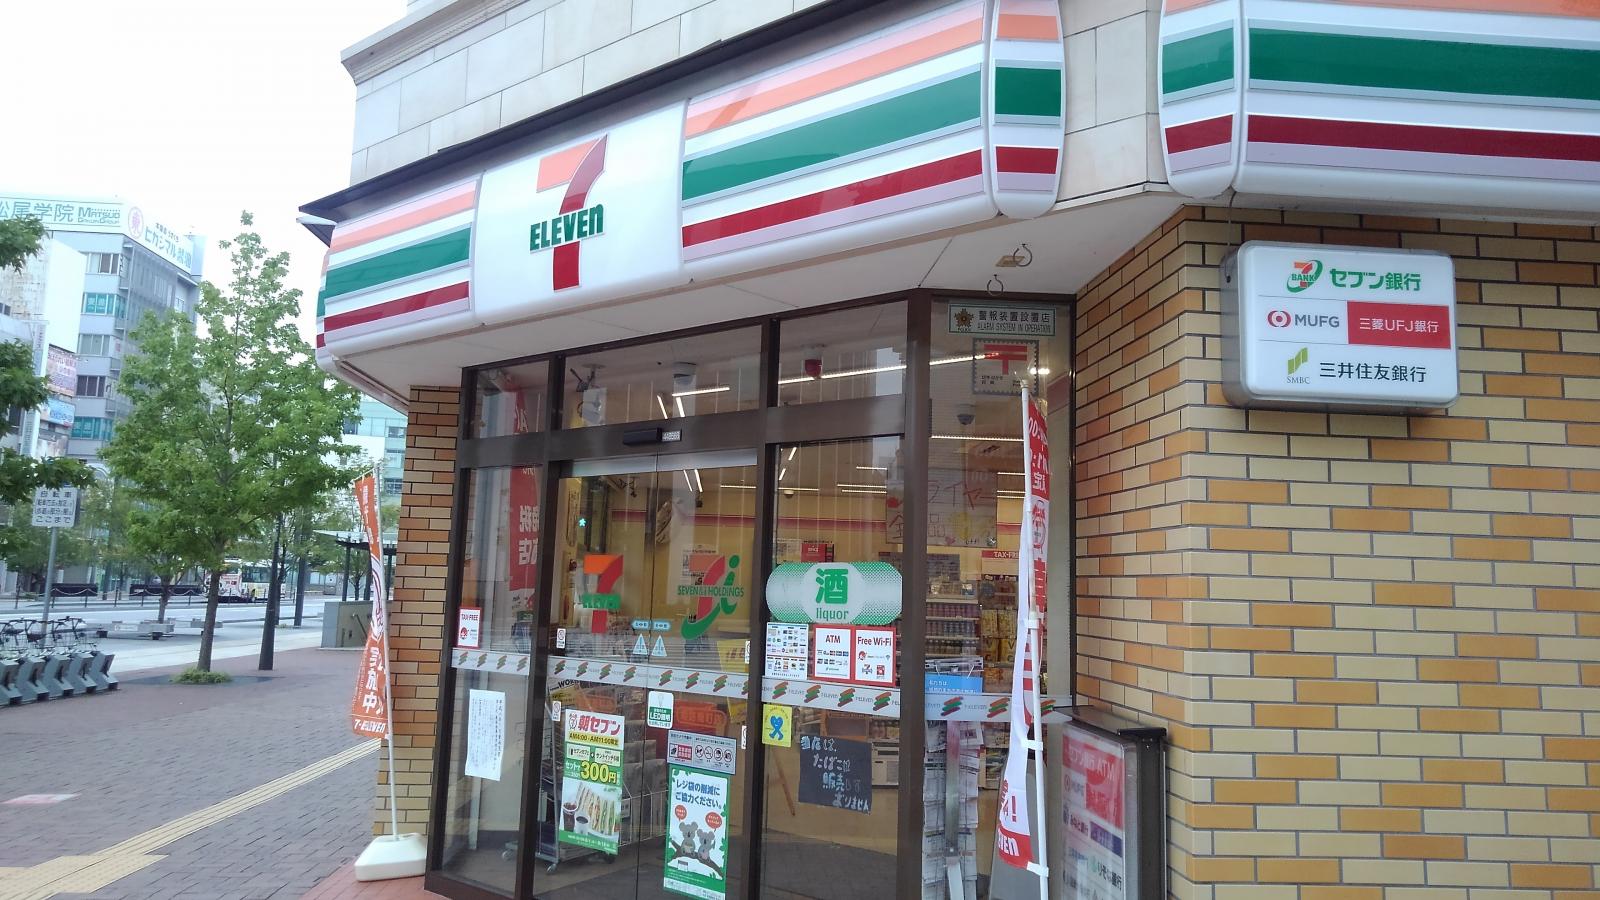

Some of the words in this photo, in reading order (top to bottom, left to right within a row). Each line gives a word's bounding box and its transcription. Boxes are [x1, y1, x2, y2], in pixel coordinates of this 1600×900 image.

[1291, 273, 1316, 283] BANK
[1329, 268, 1422, 292] セブン銀行
[1294, 314, 1341, 329] MUFG
[1359, 317, 1440, 334] 三菱UFJ銀行
[1286, 376, 1311, 386] SMBC
[1319, 362, 1428, 384] 三井住友銀行
[708, 586, 745, 597] HOLDINGS
[815, 568, 849, 605] 酒
[816, 606, 850, 623] liquor
[825, 634, 841, 644] ATM
[857, 636, 873, 646] Free
[873, 637, 892, 647] Wi-Fi
[577, 715, 621, 736] 朝セブン
[676, 778, 721, 797] レジ袋の削減に
[674, 790, 723, 810] ご協力ください。
